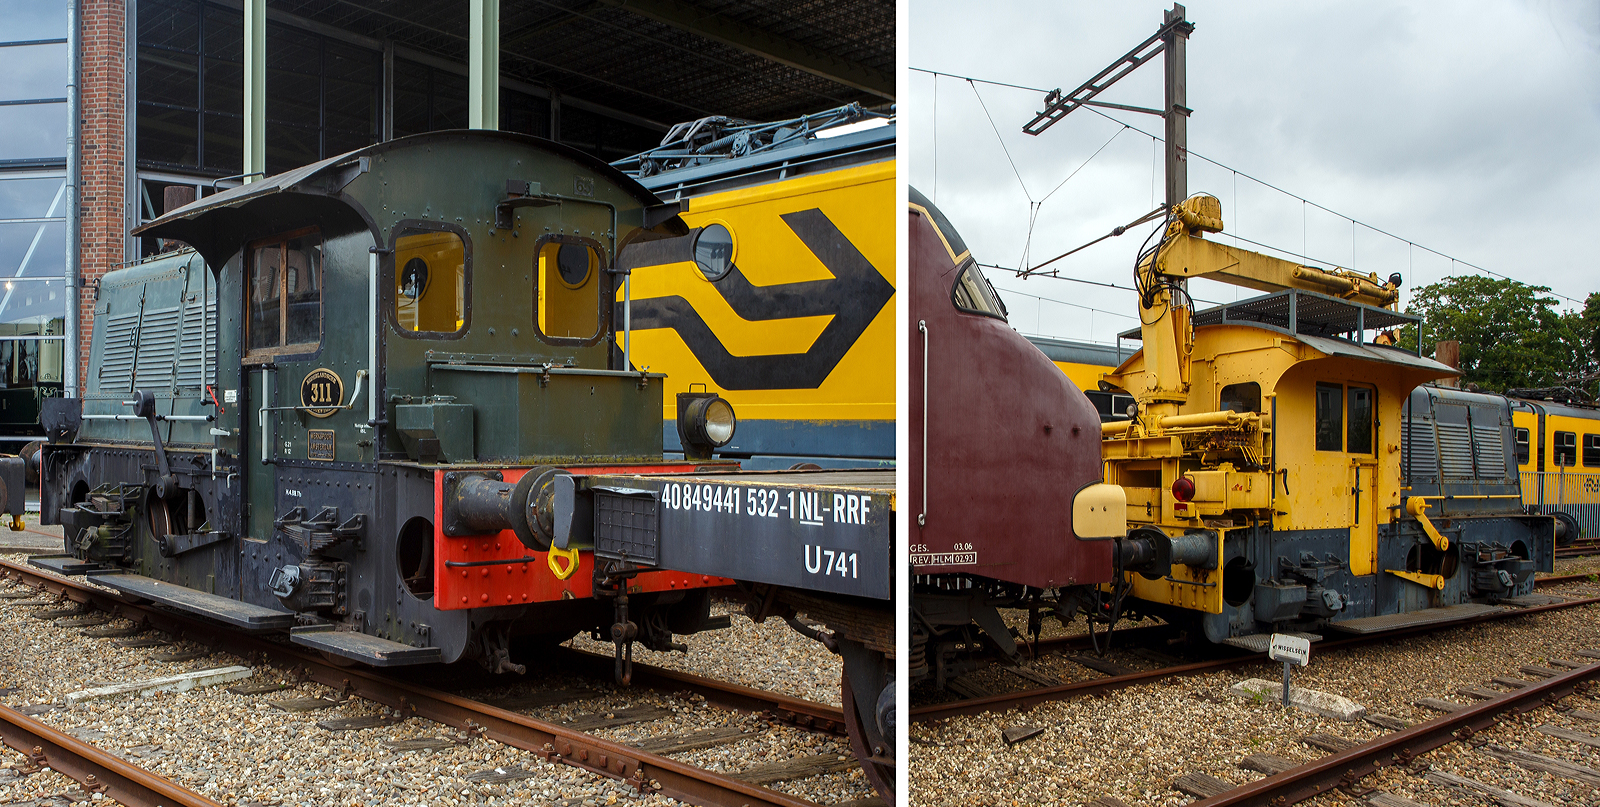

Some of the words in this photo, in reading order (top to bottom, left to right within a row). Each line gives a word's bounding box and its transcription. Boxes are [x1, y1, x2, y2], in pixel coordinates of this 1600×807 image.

[310, 382, 332, 403] 311
[909, 544, 930, 552] GES.
[953, 542, 973, 551] 03.06
[912, 556, 931, 564] REV.
[933, 555, 952, 563] HLM
[954, 554, 973, 563] 02.93
